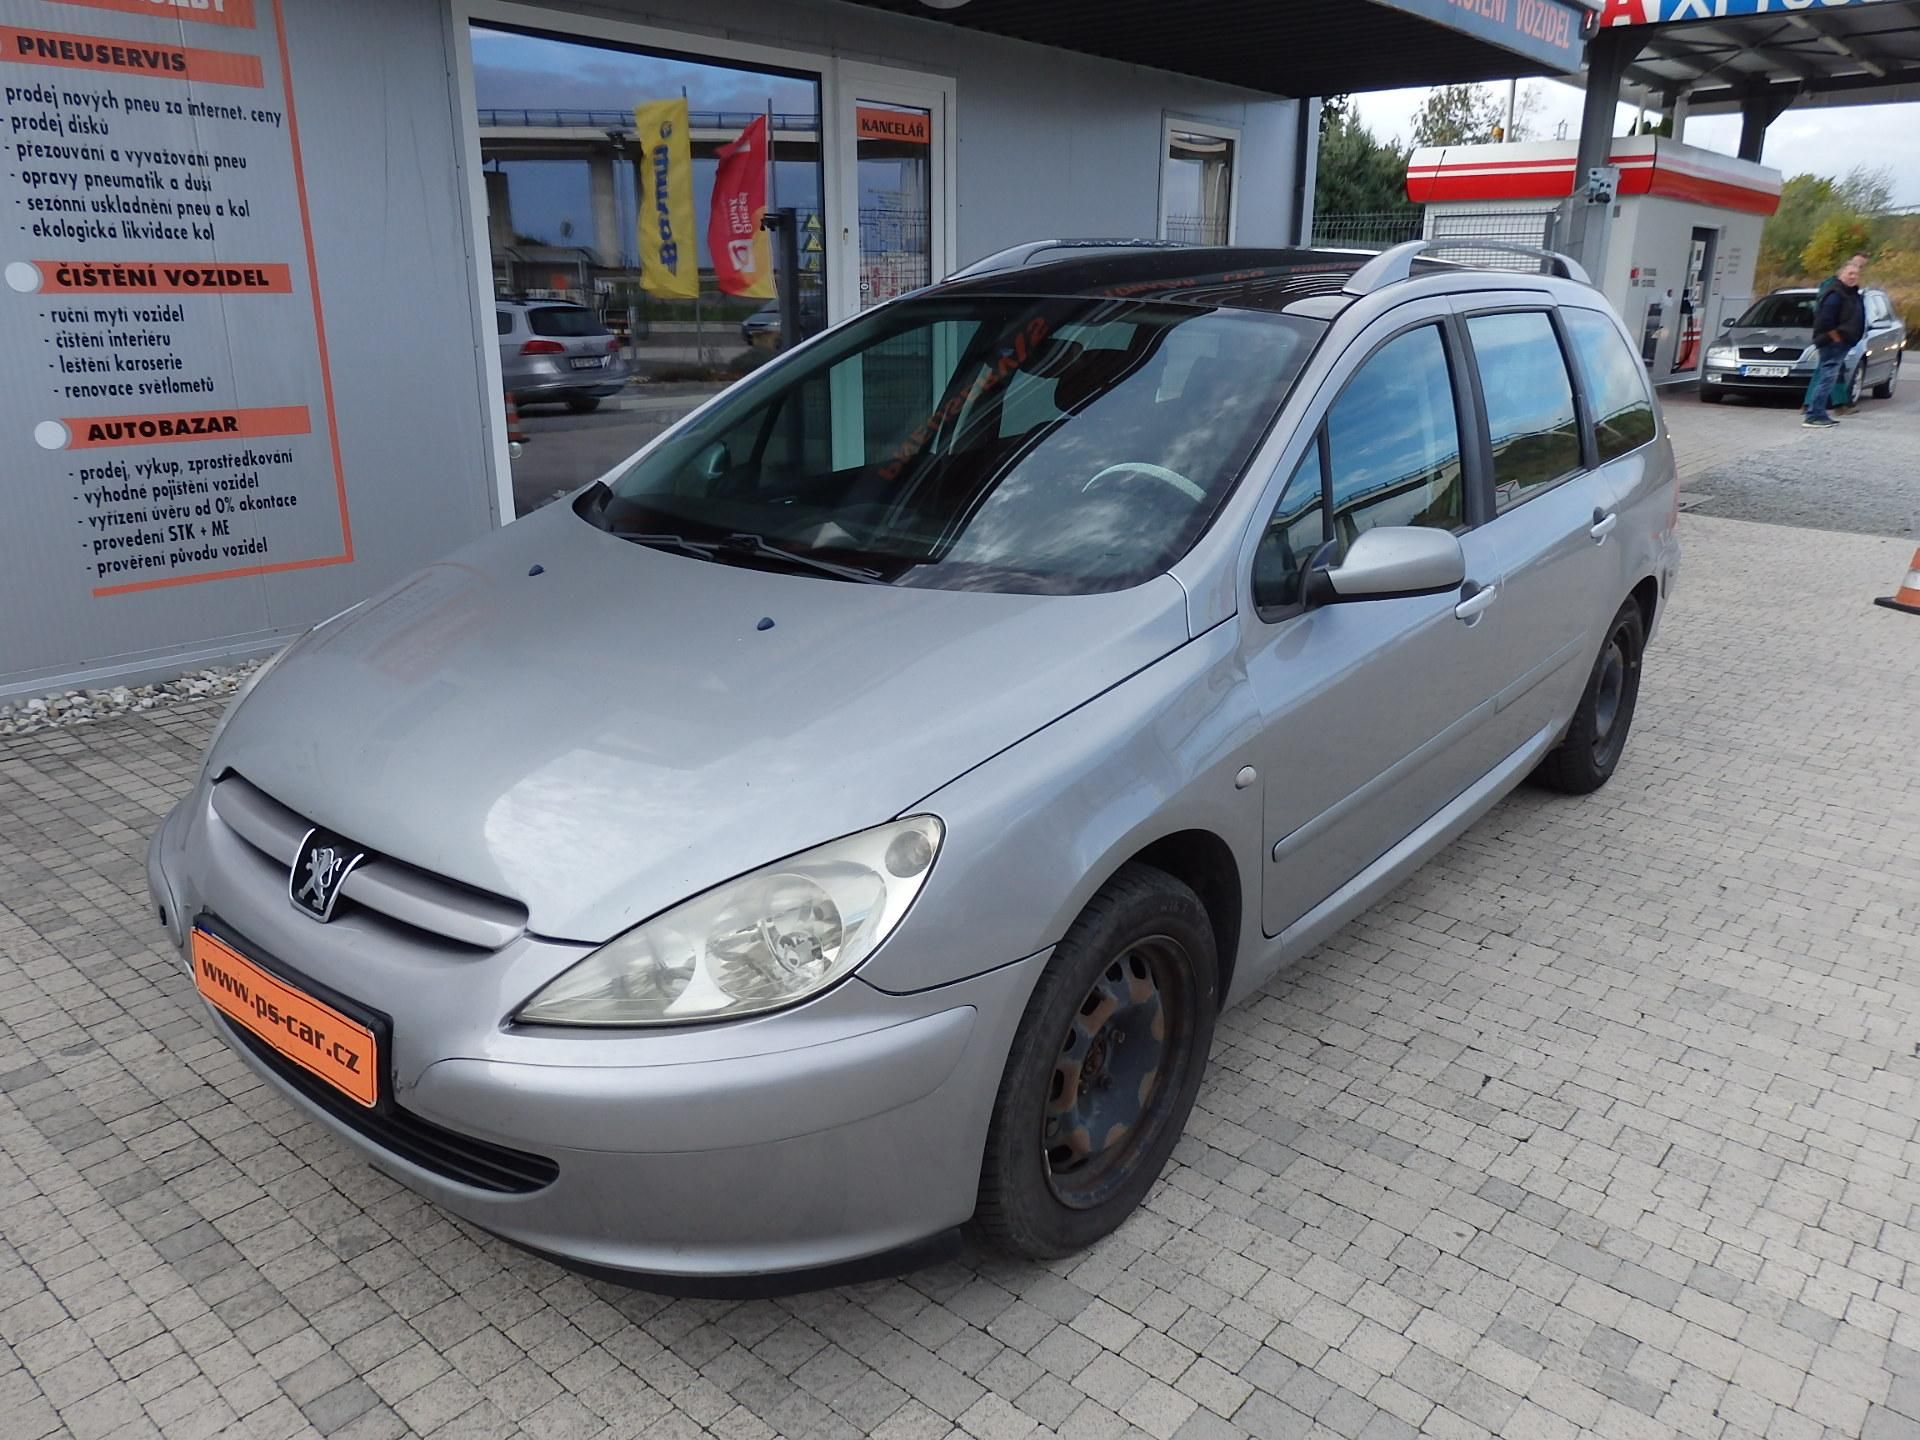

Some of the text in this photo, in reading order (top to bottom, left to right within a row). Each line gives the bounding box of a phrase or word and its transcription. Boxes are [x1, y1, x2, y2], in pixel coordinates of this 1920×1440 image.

[1515, 0, 1570, 48] VOZIDEL
[17, 35, 186, 71] PNEUSERVIS
[5, 83, 281, 128] prodej nových pneu za internet. ceny
[11, 112, 109, 137] prodej disků
[111, 150, 120, 161] a
[214, 155, 247, 171] pneu
[22, 171, 211, 192] opravy pneumatik a duší
[27, 195, 250, 218] sezónní uskladnění pneu a kol
[33, 218, 215, 243] ekologická likvidace kol
[163, 269, 269, 287] VOZIDEL
[51, 304, 184, 327] ruční mytí vozidel
[109, 329, 171, 346] interiéru
[116, 353, 183, 372] karoserie
[65, 376, 215, 398] renovace světlometů
[88, 416, 239, 441] AUTOBAZAR
[80, 460, 130, 484] prodej,
[135, 458, 183, 479] výkup,
[84, 484, 147, 508] výhodné
[212, 472, 259, 492] vozidel
[152, 504, 190, 520] úvěru
[195, 499, 211, 516] od
[215, 497, 235, 513] 0%
[239, 494, 297, 511] akontace
[93, 520, 230, 555] provedení STK + ME
[170, 546, 218, 568] původu
[223, 537, 268, 558] vozidel
[201, 957, 361, 1075] www.ps-car.cz
